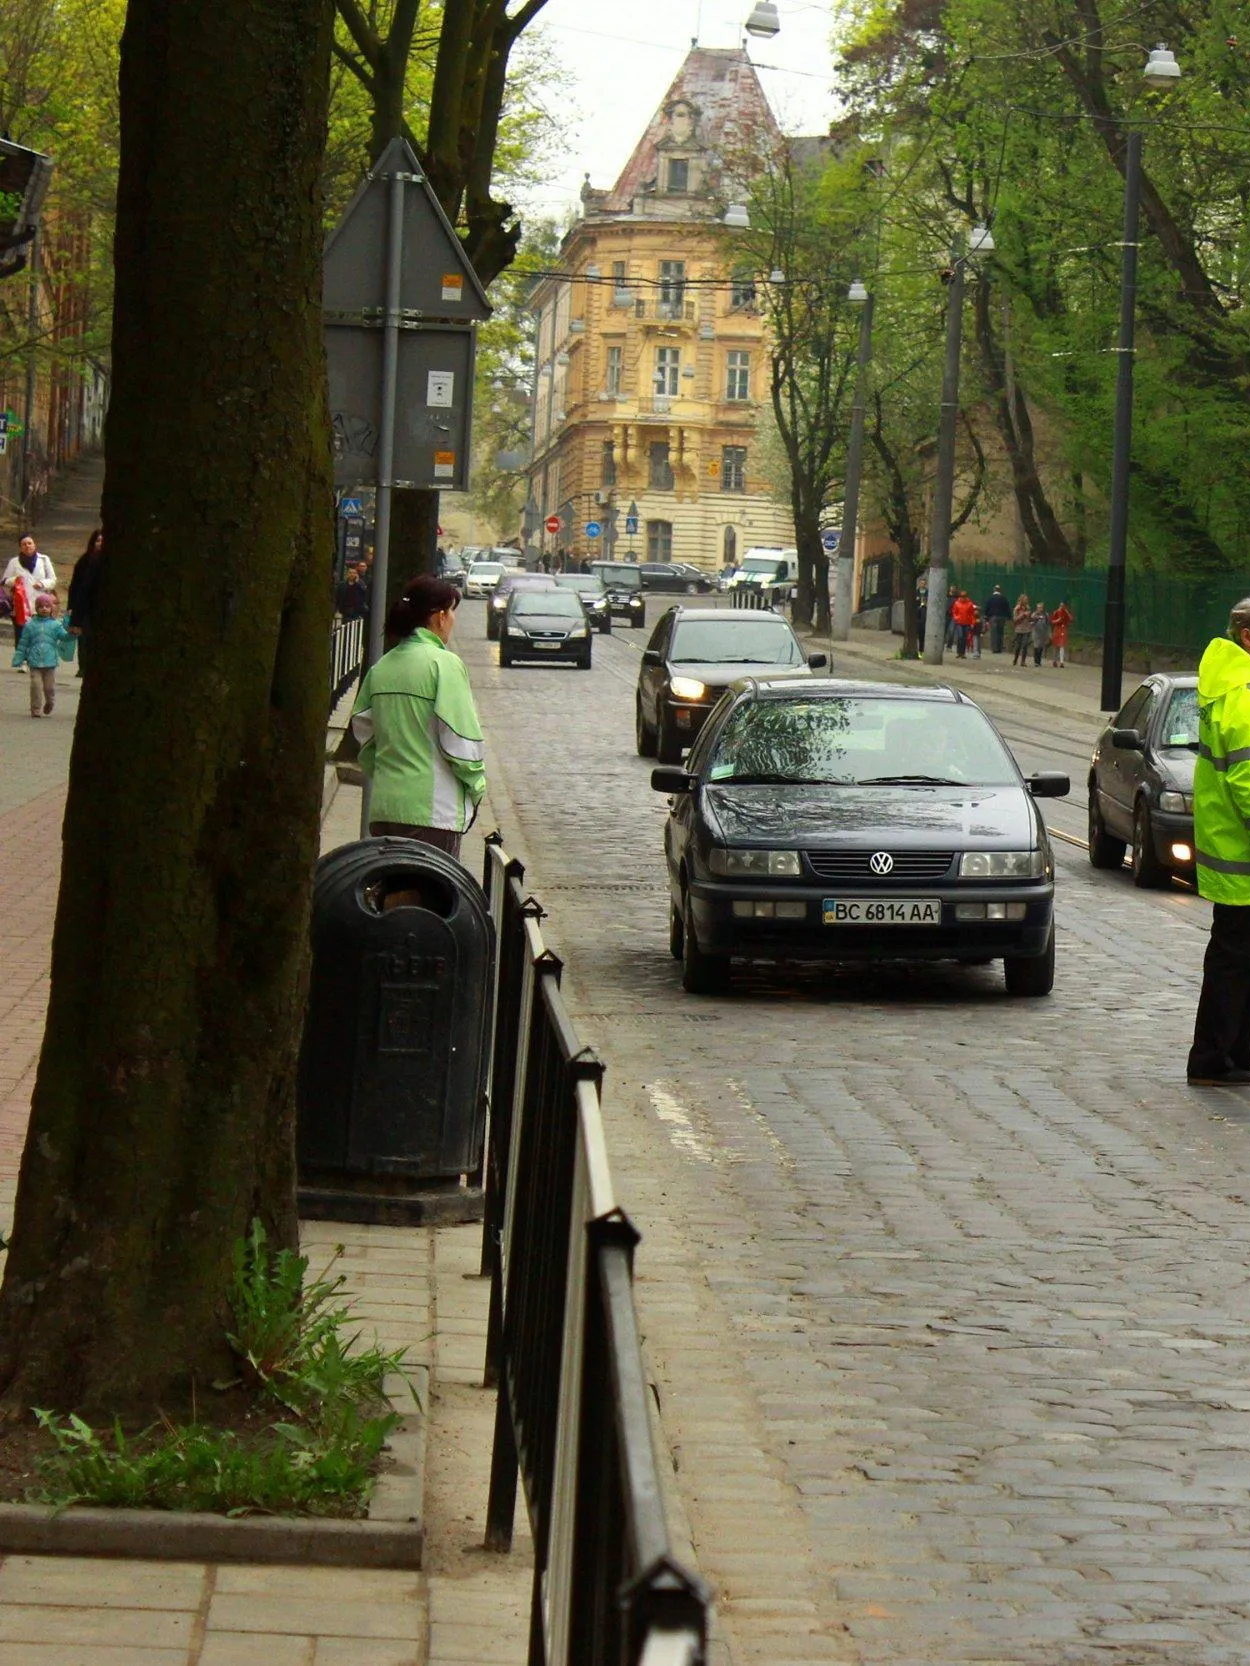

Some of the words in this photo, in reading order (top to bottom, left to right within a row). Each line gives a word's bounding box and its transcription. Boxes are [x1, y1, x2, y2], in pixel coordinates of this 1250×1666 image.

[835, 903, 861, 920] BC
[865, 903, 905, 921] 6814
[909, 904, 935, 921] AA
